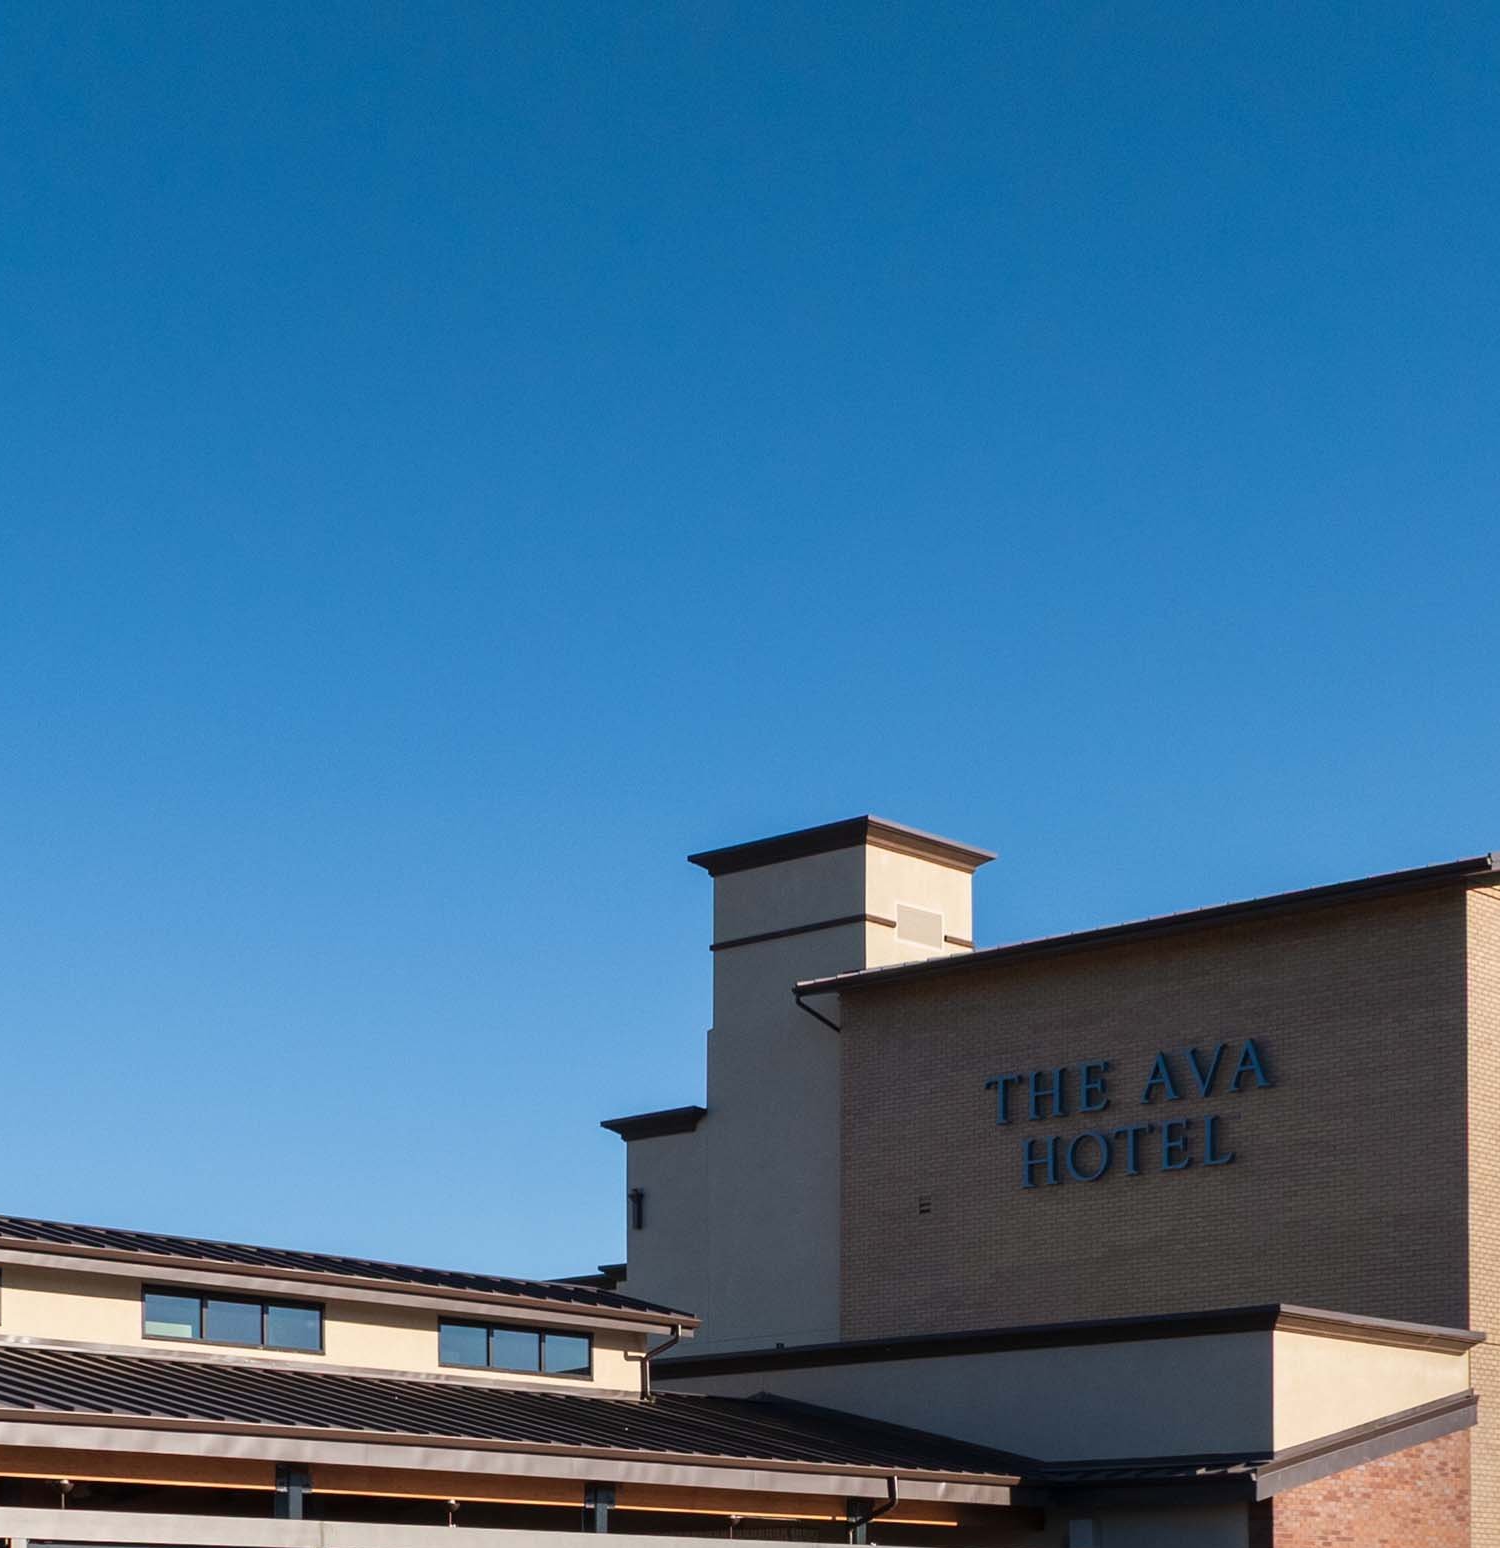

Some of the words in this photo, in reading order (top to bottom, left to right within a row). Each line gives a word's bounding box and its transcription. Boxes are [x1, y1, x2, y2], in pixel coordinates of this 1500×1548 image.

[984, 1060, 1110, 1126] THE
[1141, 1039, 1271, 1104] AVA
[1020, 1115, 1237, 1189] HOTEL
